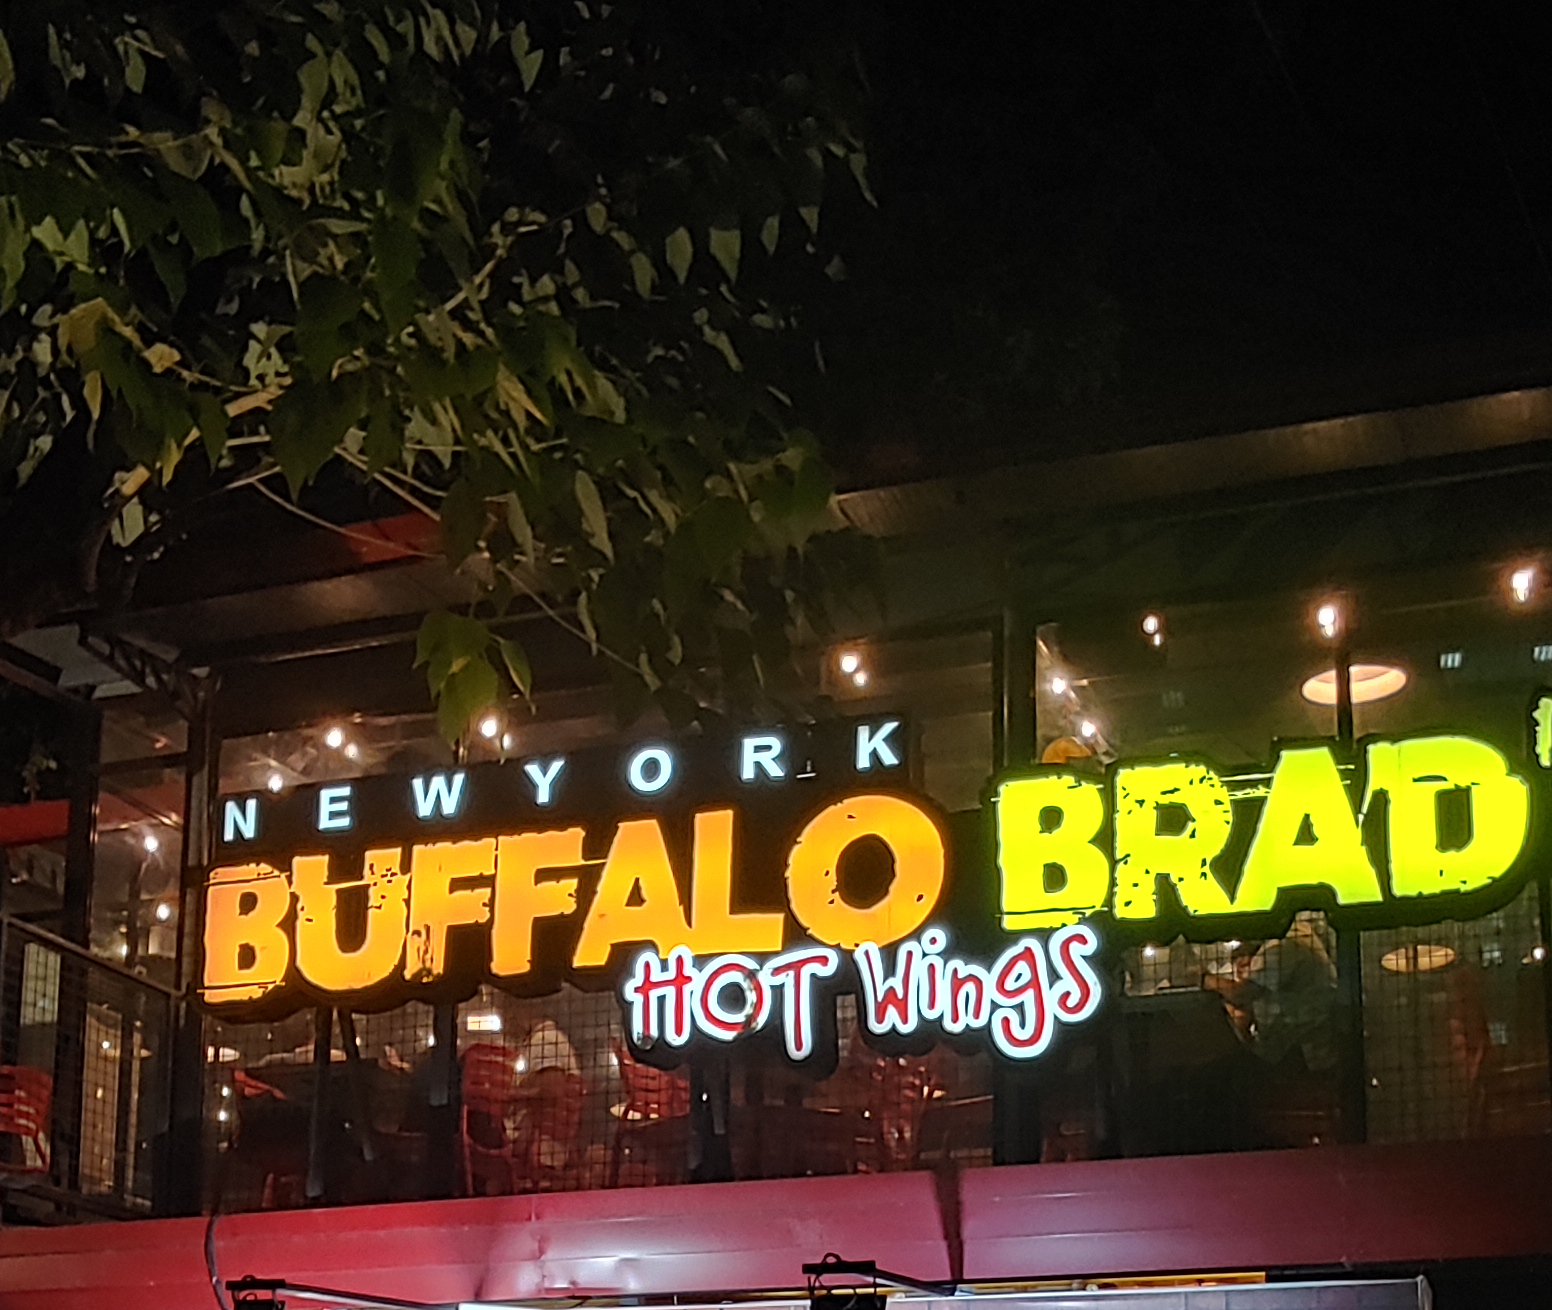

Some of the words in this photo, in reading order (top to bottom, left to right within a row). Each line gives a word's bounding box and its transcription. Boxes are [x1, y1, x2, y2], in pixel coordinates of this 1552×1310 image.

[203, 794, 946, 1004] BUFFALO
[625, 944, 838, 1061] HOT
[852, 923, 1101, 1059] Wings
